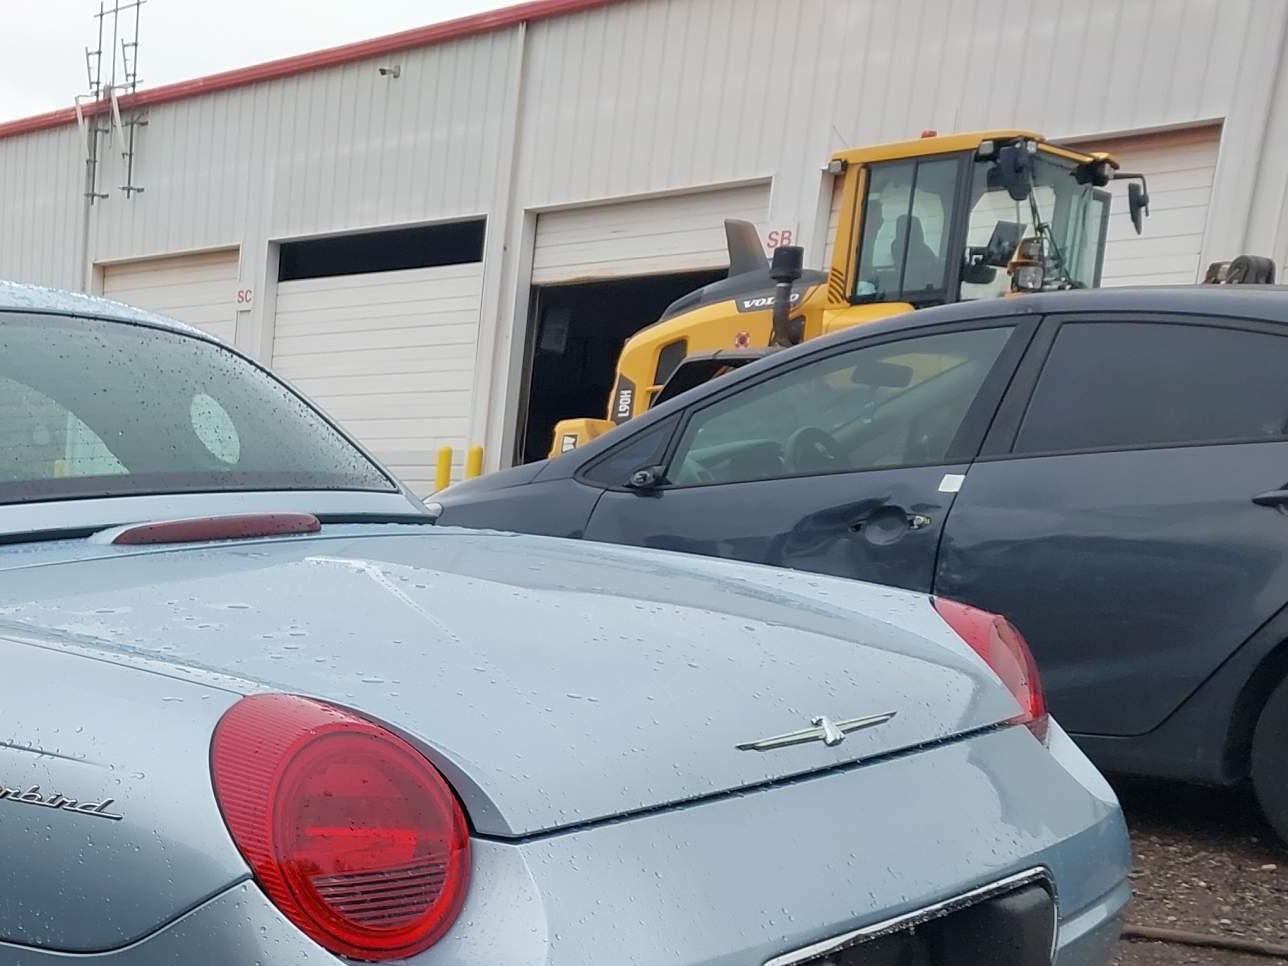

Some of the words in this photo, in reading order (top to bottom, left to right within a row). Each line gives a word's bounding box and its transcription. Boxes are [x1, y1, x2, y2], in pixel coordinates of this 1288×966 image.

[767, 230, 792, 248] SB
[237, 289, 253, 304] SC
[744, 294, 799, 308] VOLO
[618, 390, 632, 417] L90H
